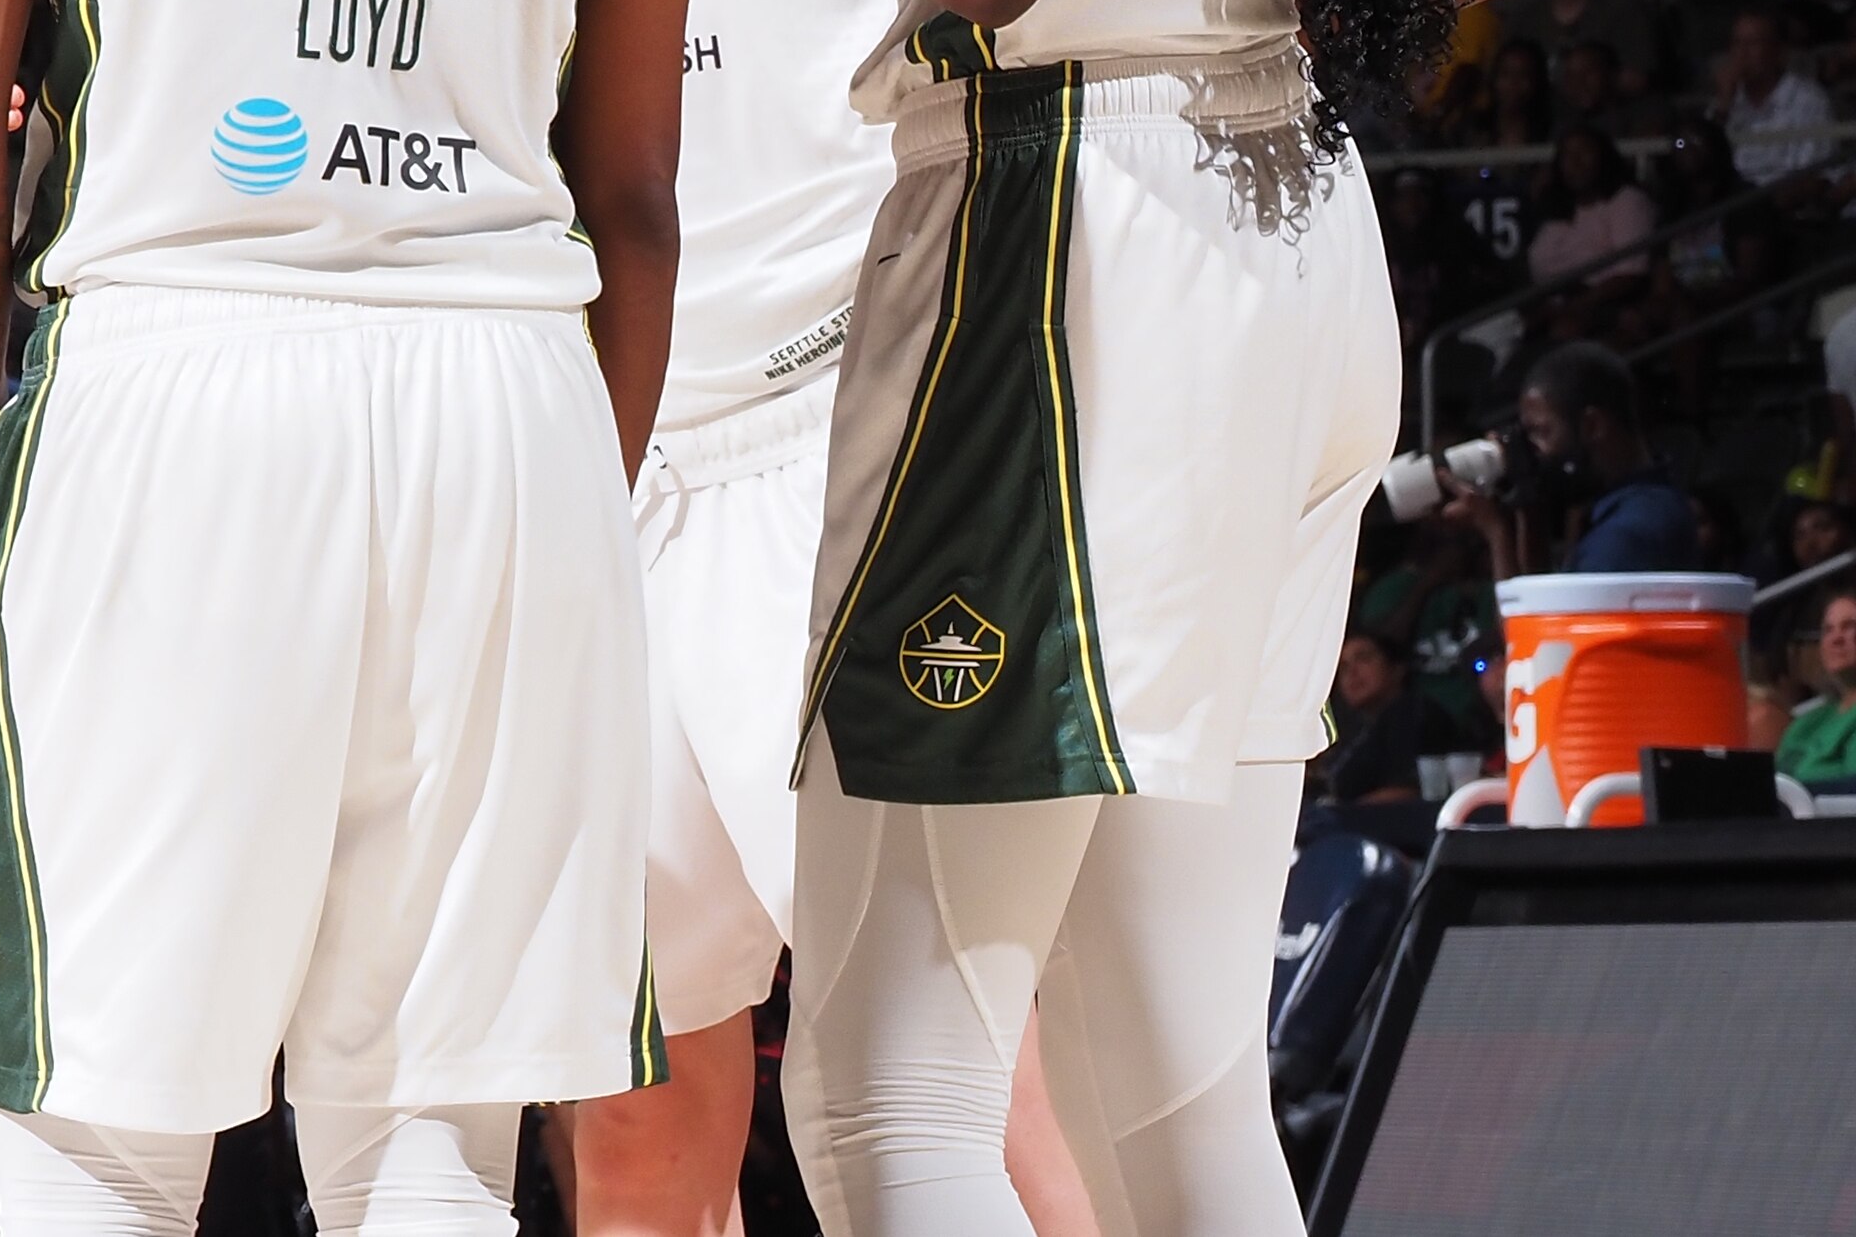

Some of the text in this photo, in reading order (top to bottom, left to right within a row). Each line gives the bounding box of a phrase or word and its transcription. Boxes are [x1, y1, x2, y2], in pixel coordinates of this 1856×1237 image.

[321, 123, 476, 194] AT&T
[768, 324, 830, 366] SEATTLE
[764, 361, 796, 381] NIKE
